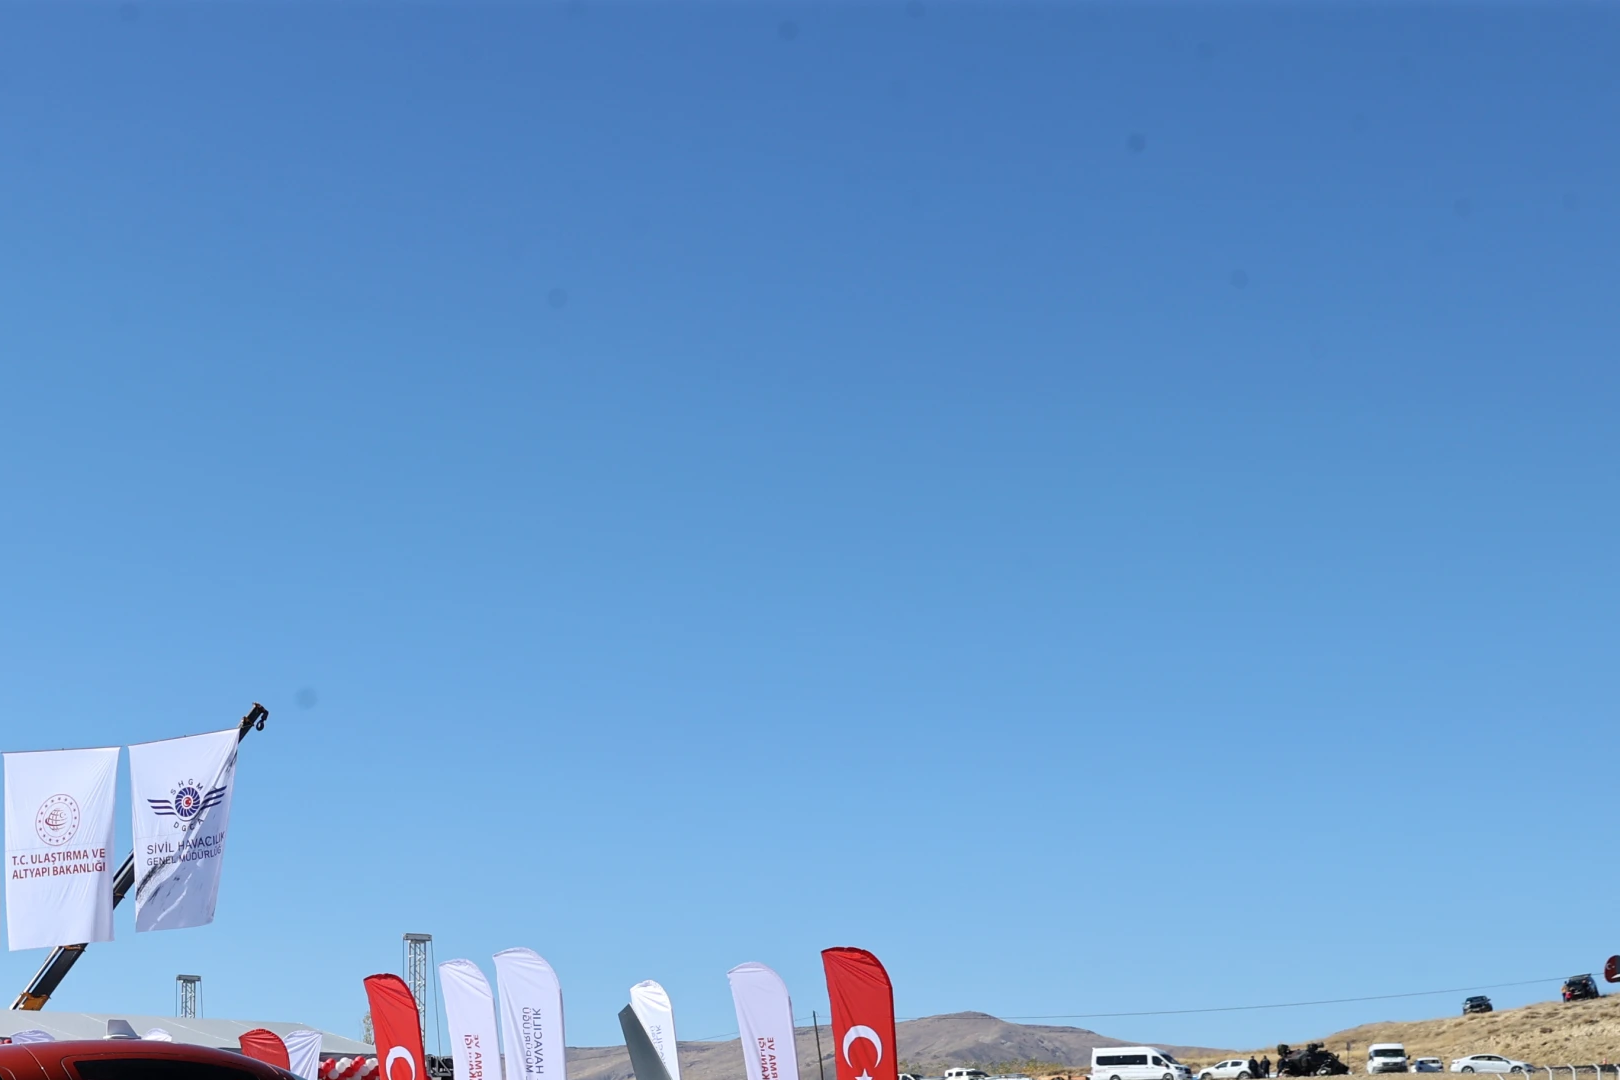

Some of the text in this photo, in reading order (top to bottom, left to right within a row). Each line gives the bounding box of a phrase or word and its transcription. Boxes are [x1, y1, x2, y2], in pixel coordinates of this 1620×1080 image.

[170, 778, 204, 796] SHGM
[173, 818, 204, 832] DGCA
[146, 831, 225, 855] SİVİL HAVACILIK
[12, 848, 106, 866] T.C. ULAŞTIRMA VE
[146, 855, 177, 866] GENEL
[12, 859, 106, 880] ALTYAPI BAKANLIĞI
